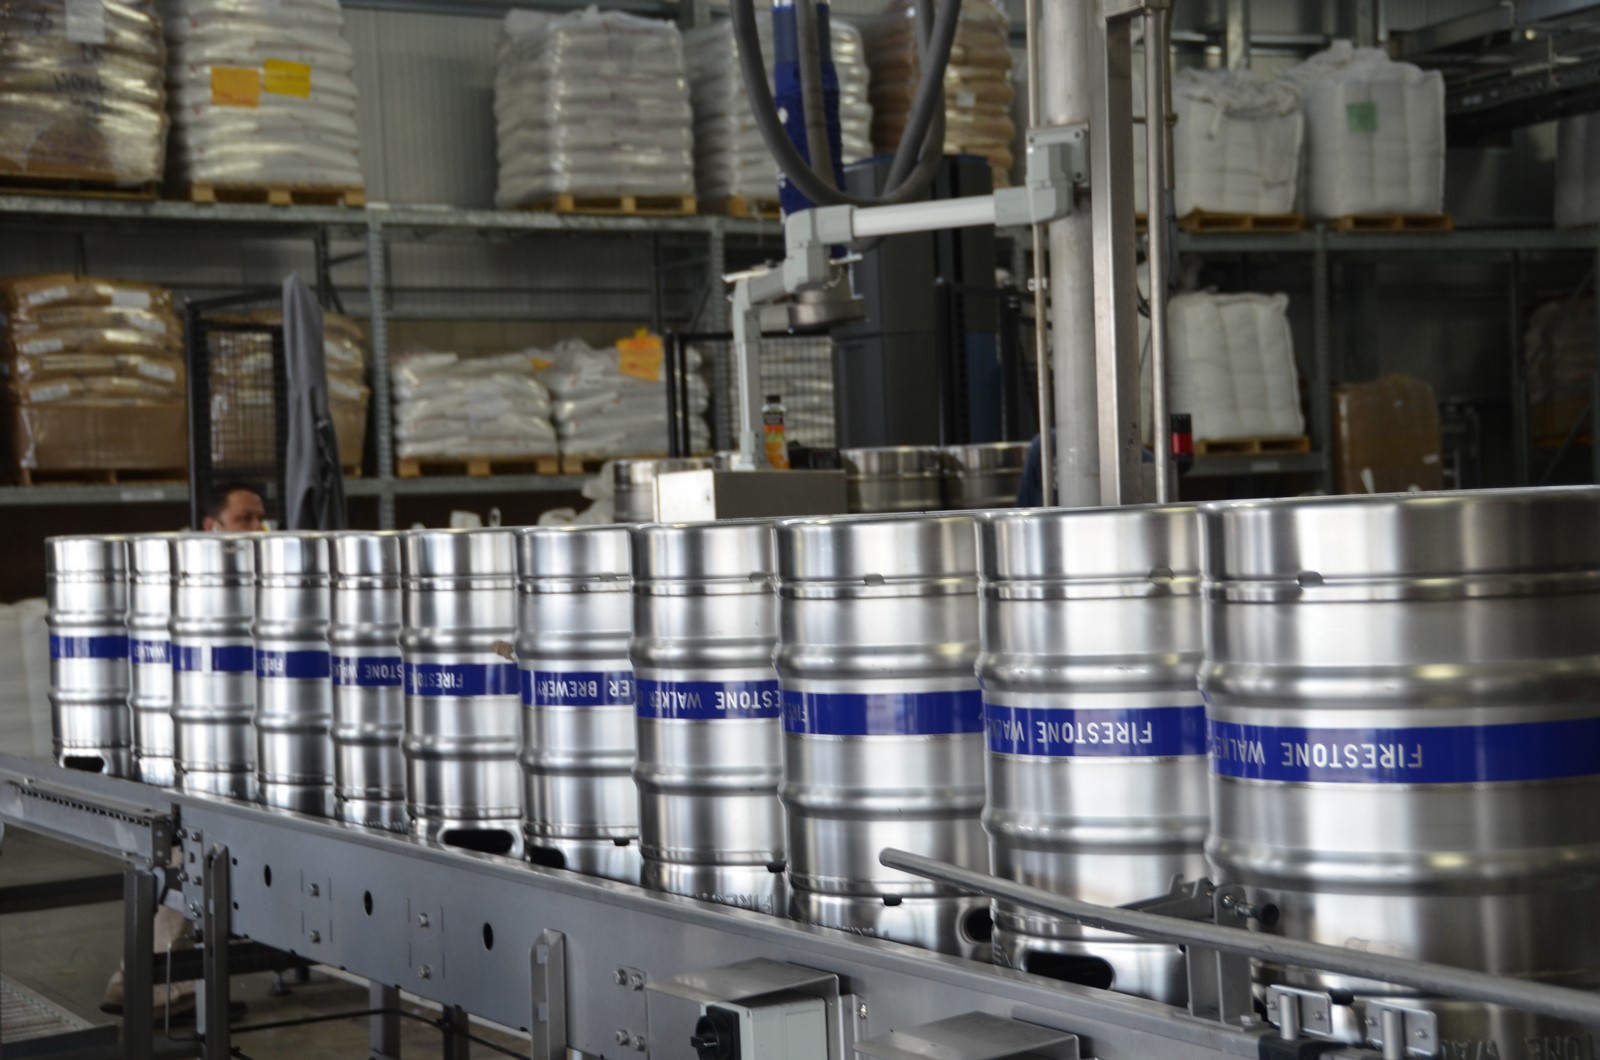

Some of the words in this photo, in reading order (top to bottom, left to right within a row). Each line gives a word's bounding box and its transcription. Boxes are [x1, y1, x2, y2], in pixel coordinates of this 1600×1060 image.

[537, 680, 598, 698] BREWERY
[649, 691, 703, 710] WALKER
[1036, 720, 1153, 745] FIRESTONE
[1280, 742, 1423, 769] FIRESTONE
